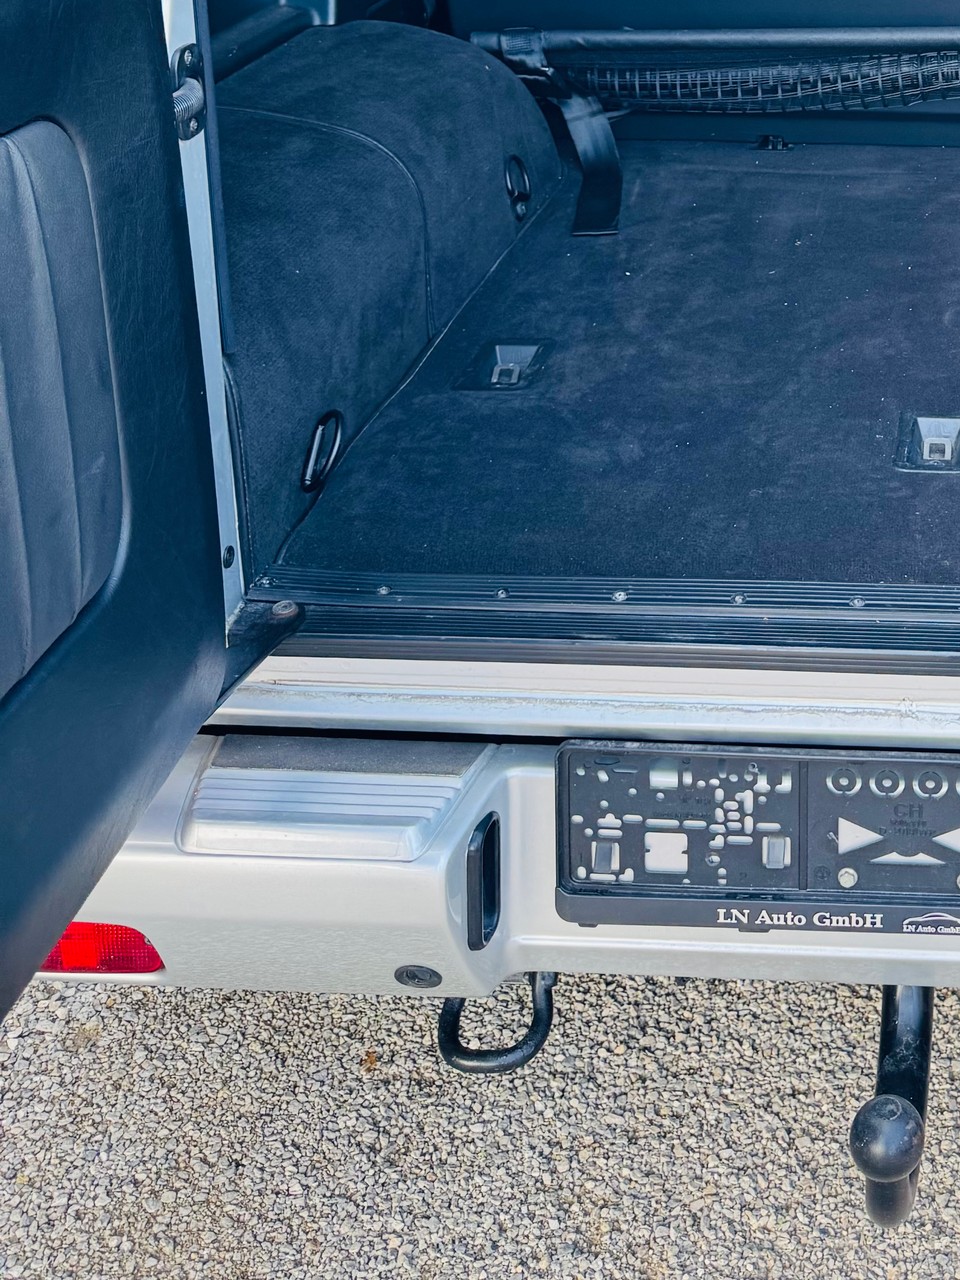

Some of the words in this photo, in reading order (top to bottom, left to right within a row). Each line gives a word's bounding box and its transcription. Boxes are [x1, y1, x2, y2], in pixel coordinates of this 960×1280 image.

[716, 908, 750, 924] LN
[754, 909, 807, 926] Auto
[812, 911, 884, 928] GmbH
